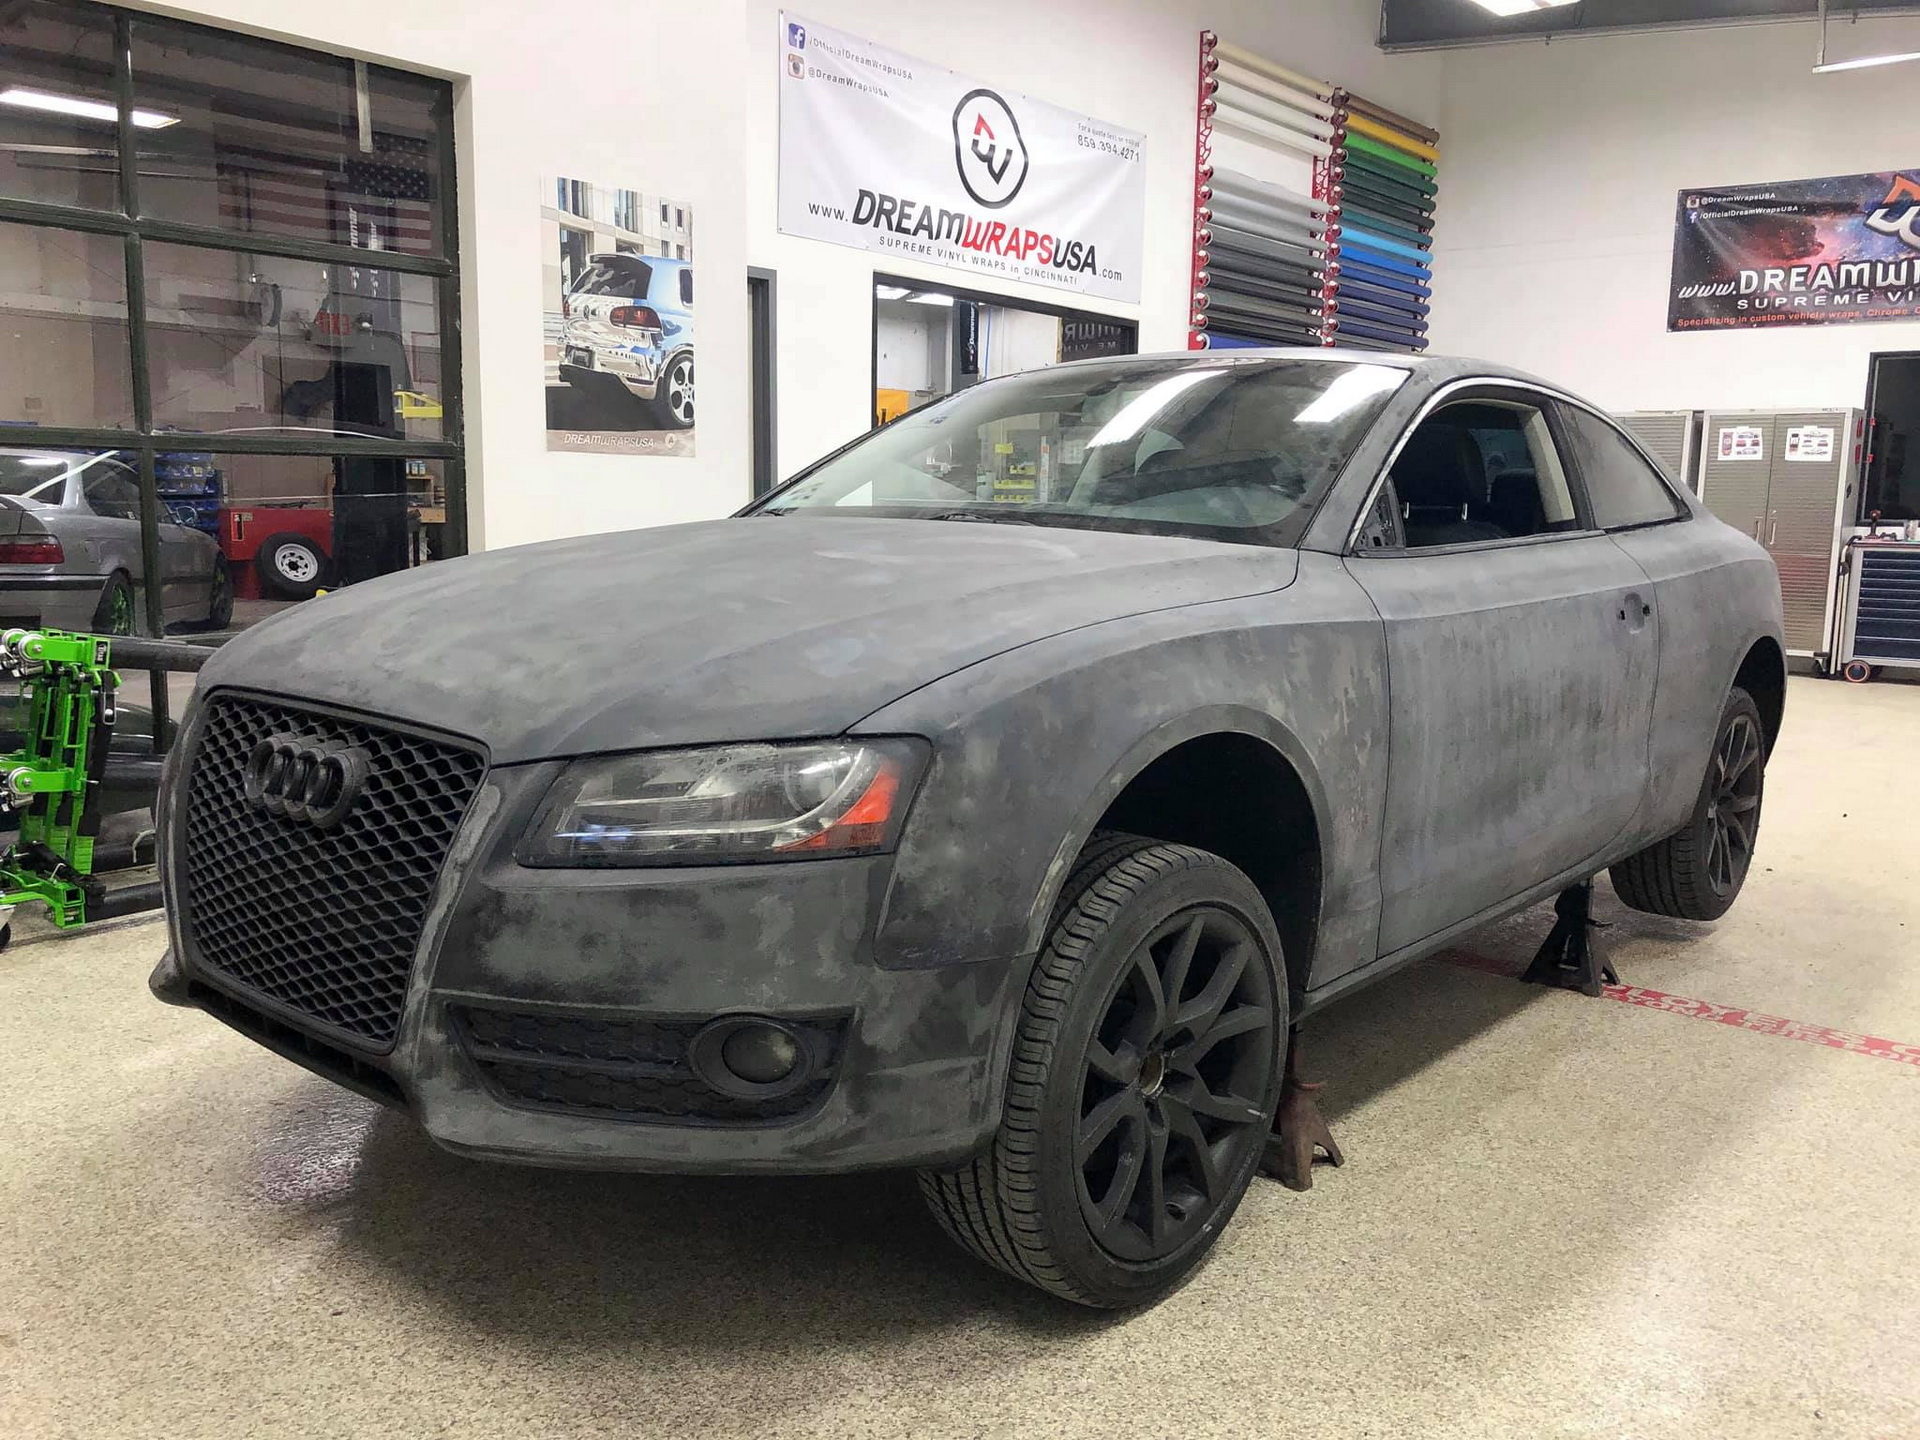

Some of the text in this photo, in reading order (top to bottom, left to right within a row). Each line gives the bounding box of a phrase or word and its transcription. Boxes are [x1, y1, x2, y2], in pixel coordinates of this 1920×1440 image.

[808, 67, 889, 98] @DreamWrapsUSA
[1078, 134, 1139, 163] 859.394.4271
[1701, 192, 1776, 206] @DreamWrapsUSA
[1700, 205, 1798, 219] /OfficialDreamWrapsUSA
[879, 236, 1078, 286] SUPREME VINYL WRAPS in CINCINNATI
[1737, 292, 1870, 310] SUPREME
[1678, 317, 1736, 328] Specializing
[1749, 313, 1786, 322] custom
